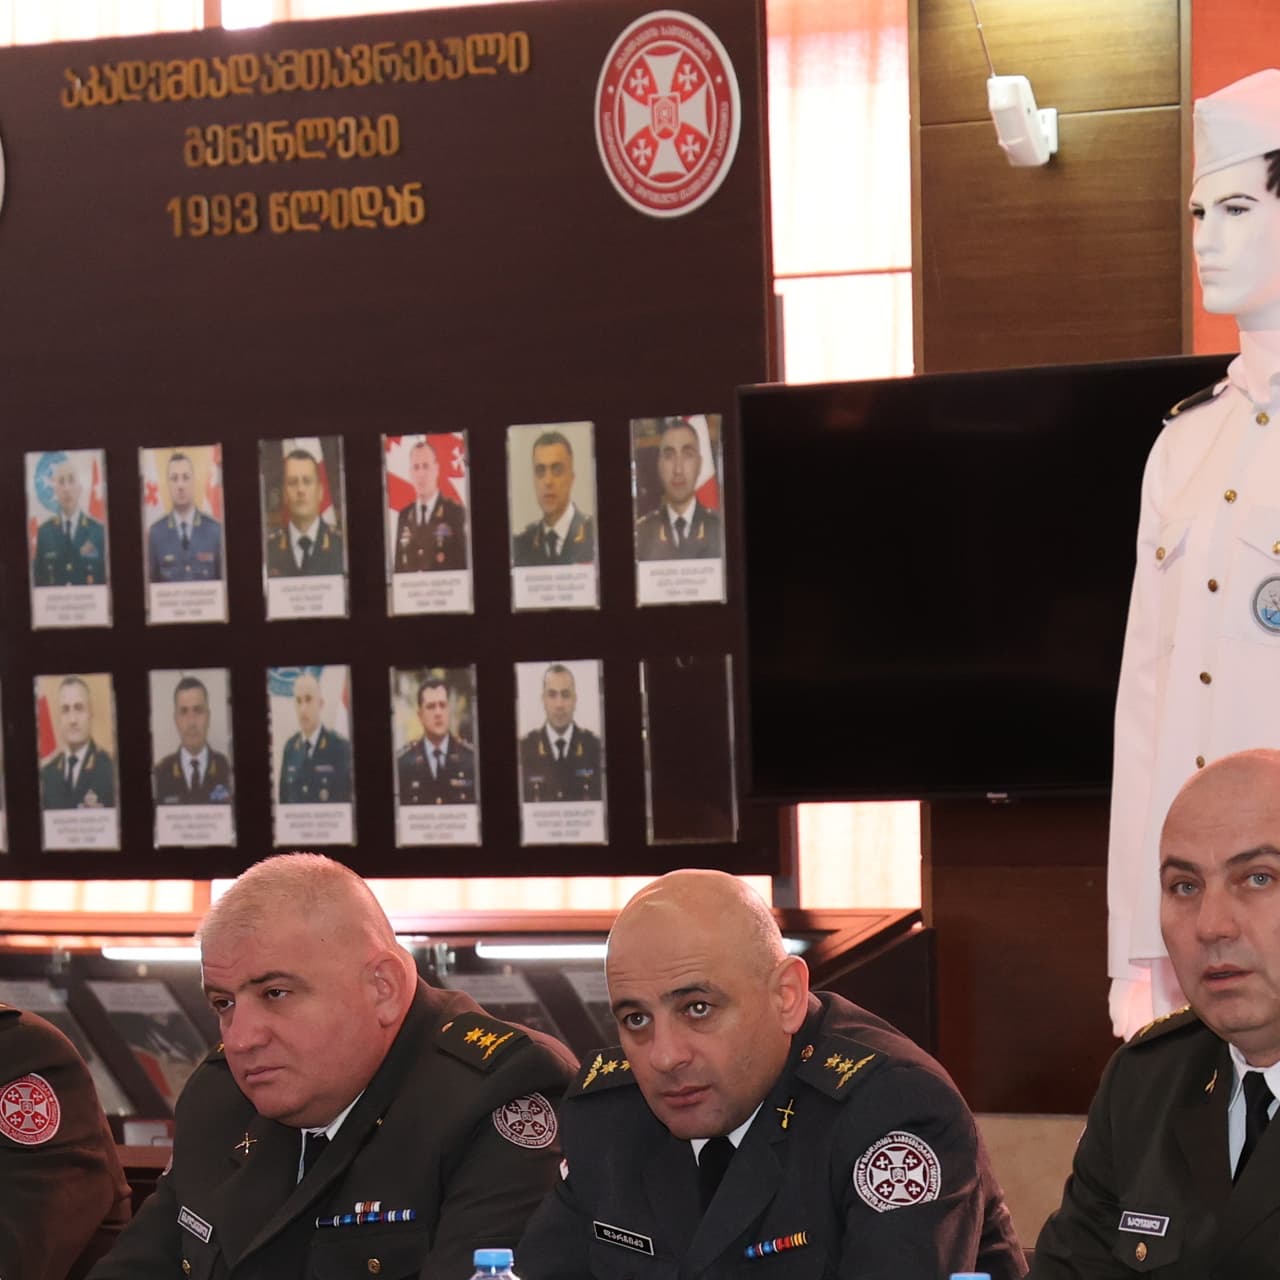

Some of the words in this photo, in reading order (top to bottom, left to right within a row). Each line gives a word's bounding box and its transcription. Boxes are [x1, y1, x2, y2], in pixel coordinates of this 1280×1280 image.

[184, 114, 400, 168] გენერლები
[166, 192, 258, 238] 1993
[269, 183, 426, 233] წლიდან
